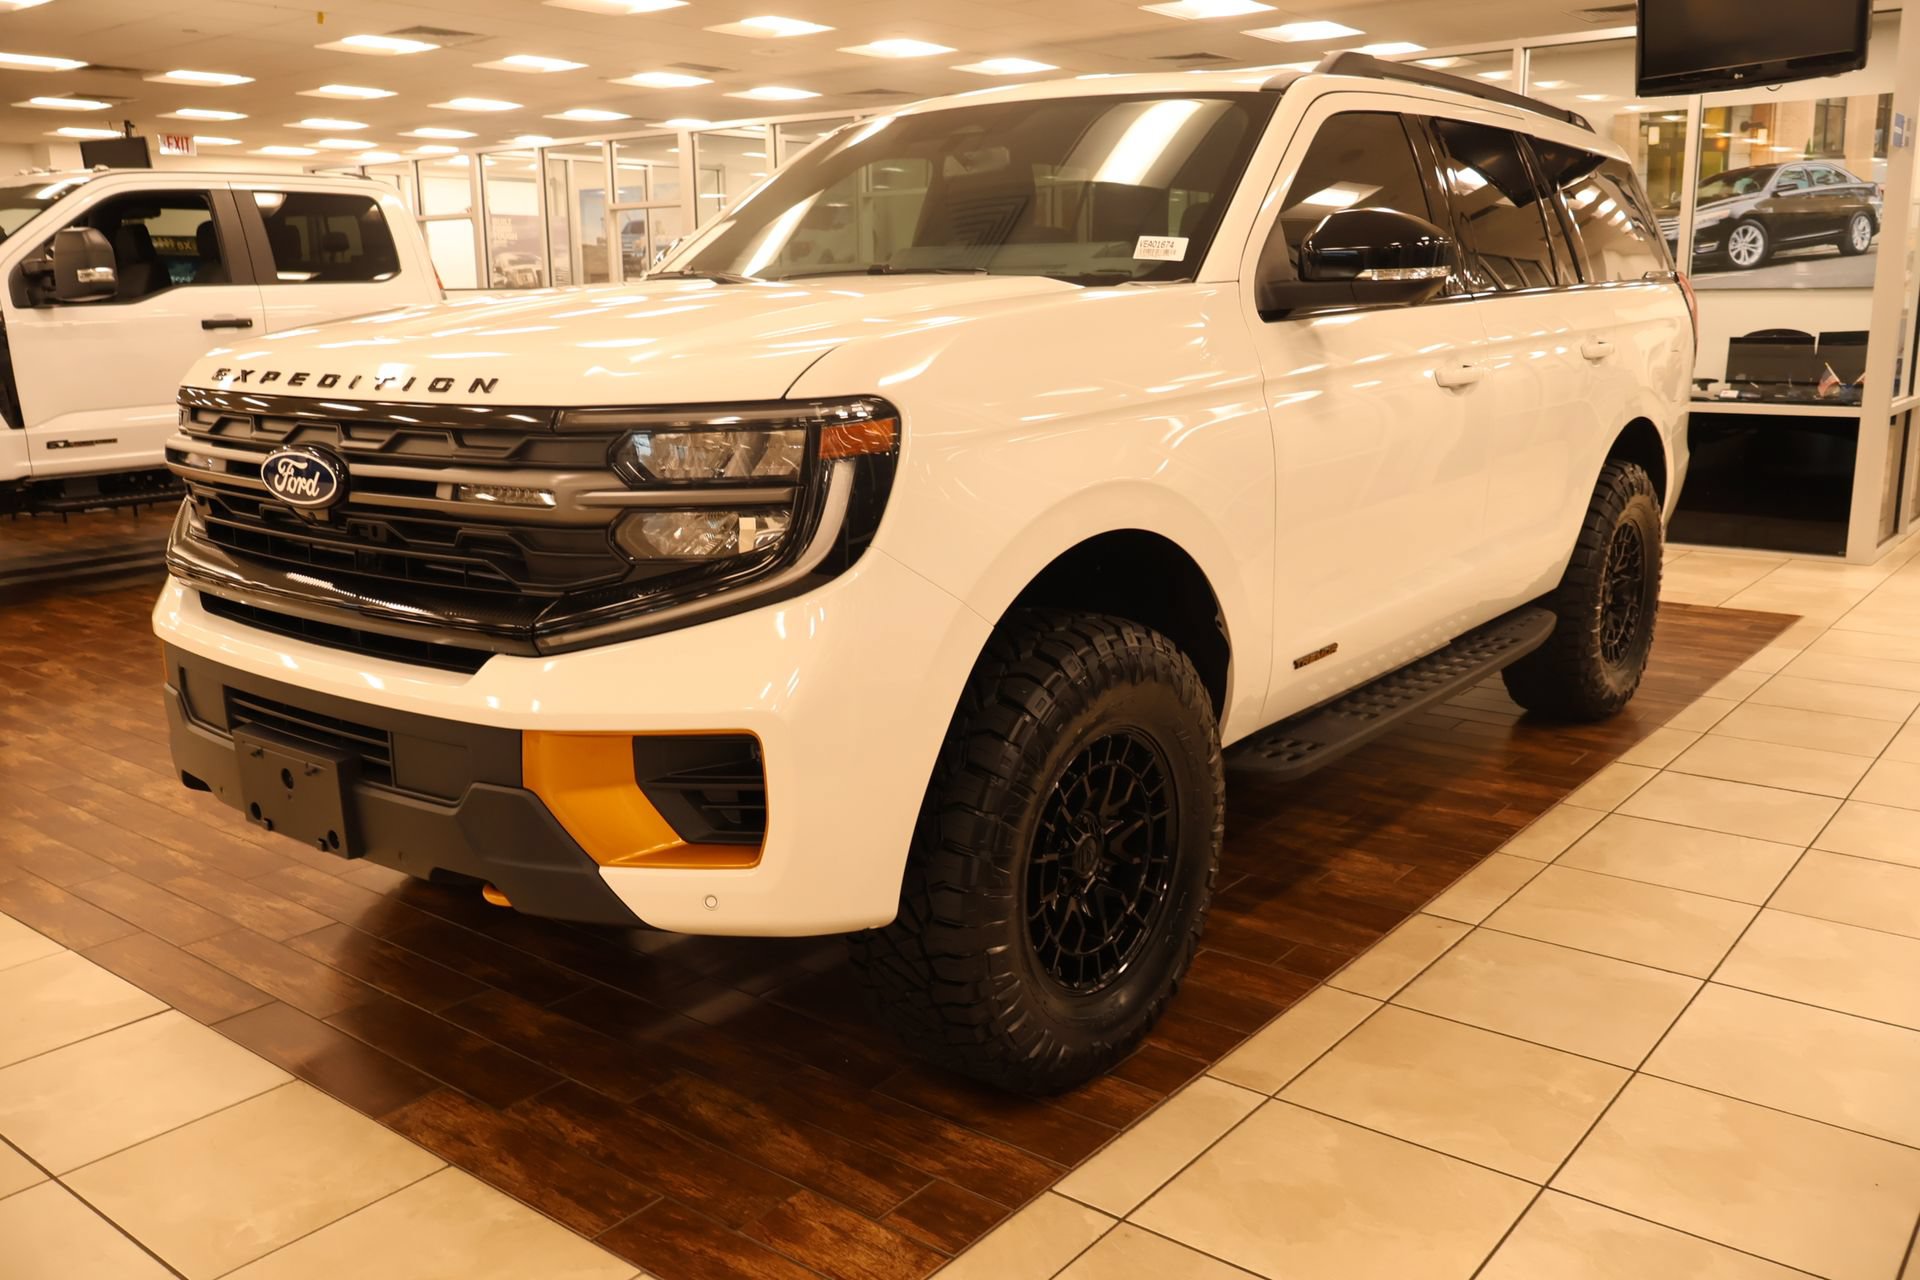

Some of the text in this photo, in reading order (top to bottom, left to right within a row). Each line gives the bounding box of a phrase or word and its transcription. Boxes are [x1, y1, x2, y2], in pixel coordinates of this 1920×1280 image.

[167, 135, 190, 153] EXIT
[212, 368, 499, 394] EXPEDITION
[274, 458, 321, 497] Ford
